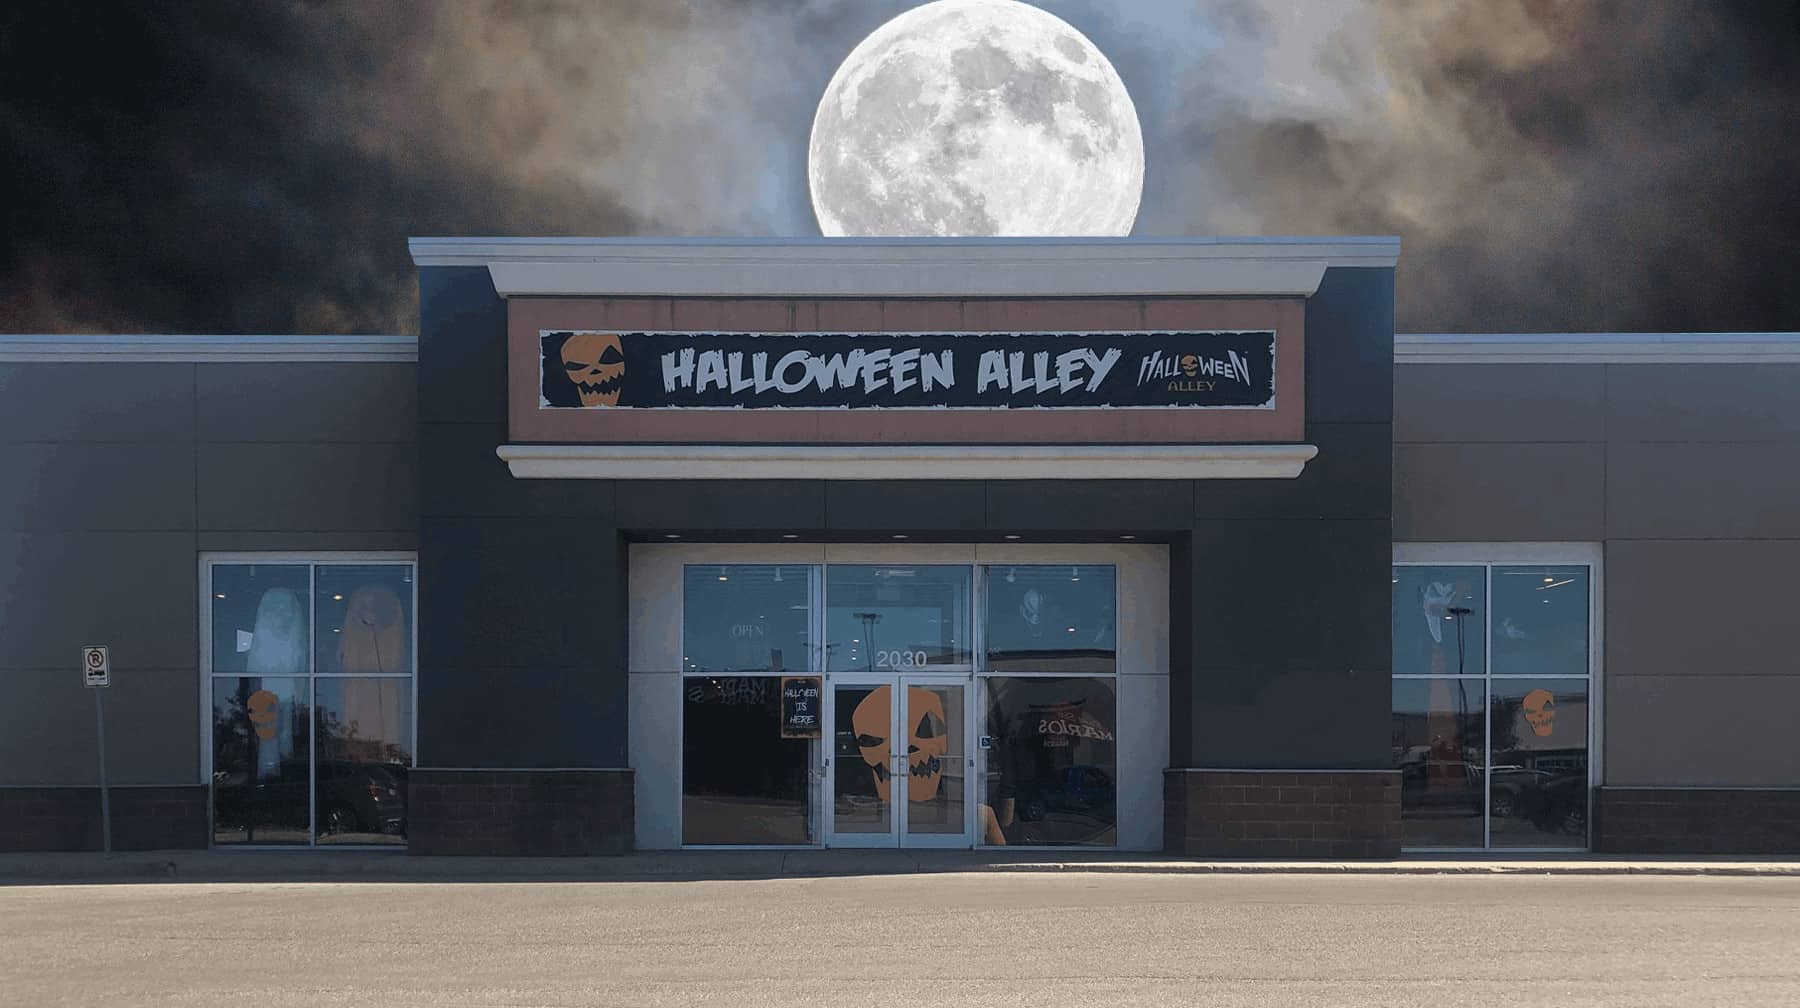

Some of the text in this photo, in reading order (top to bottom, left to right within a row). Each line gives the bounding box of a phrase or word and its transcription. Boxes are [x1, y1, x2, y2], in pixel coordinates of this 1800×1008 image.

[661, 347, 1122, 394] HALLOWEEN ALLEY
[1167, 380, 1216, 391] ALLEY
[876, 650, 927, 667] 2030
[795, 702, 807, 711] IS
[790, 715, 816, 725] HERE
